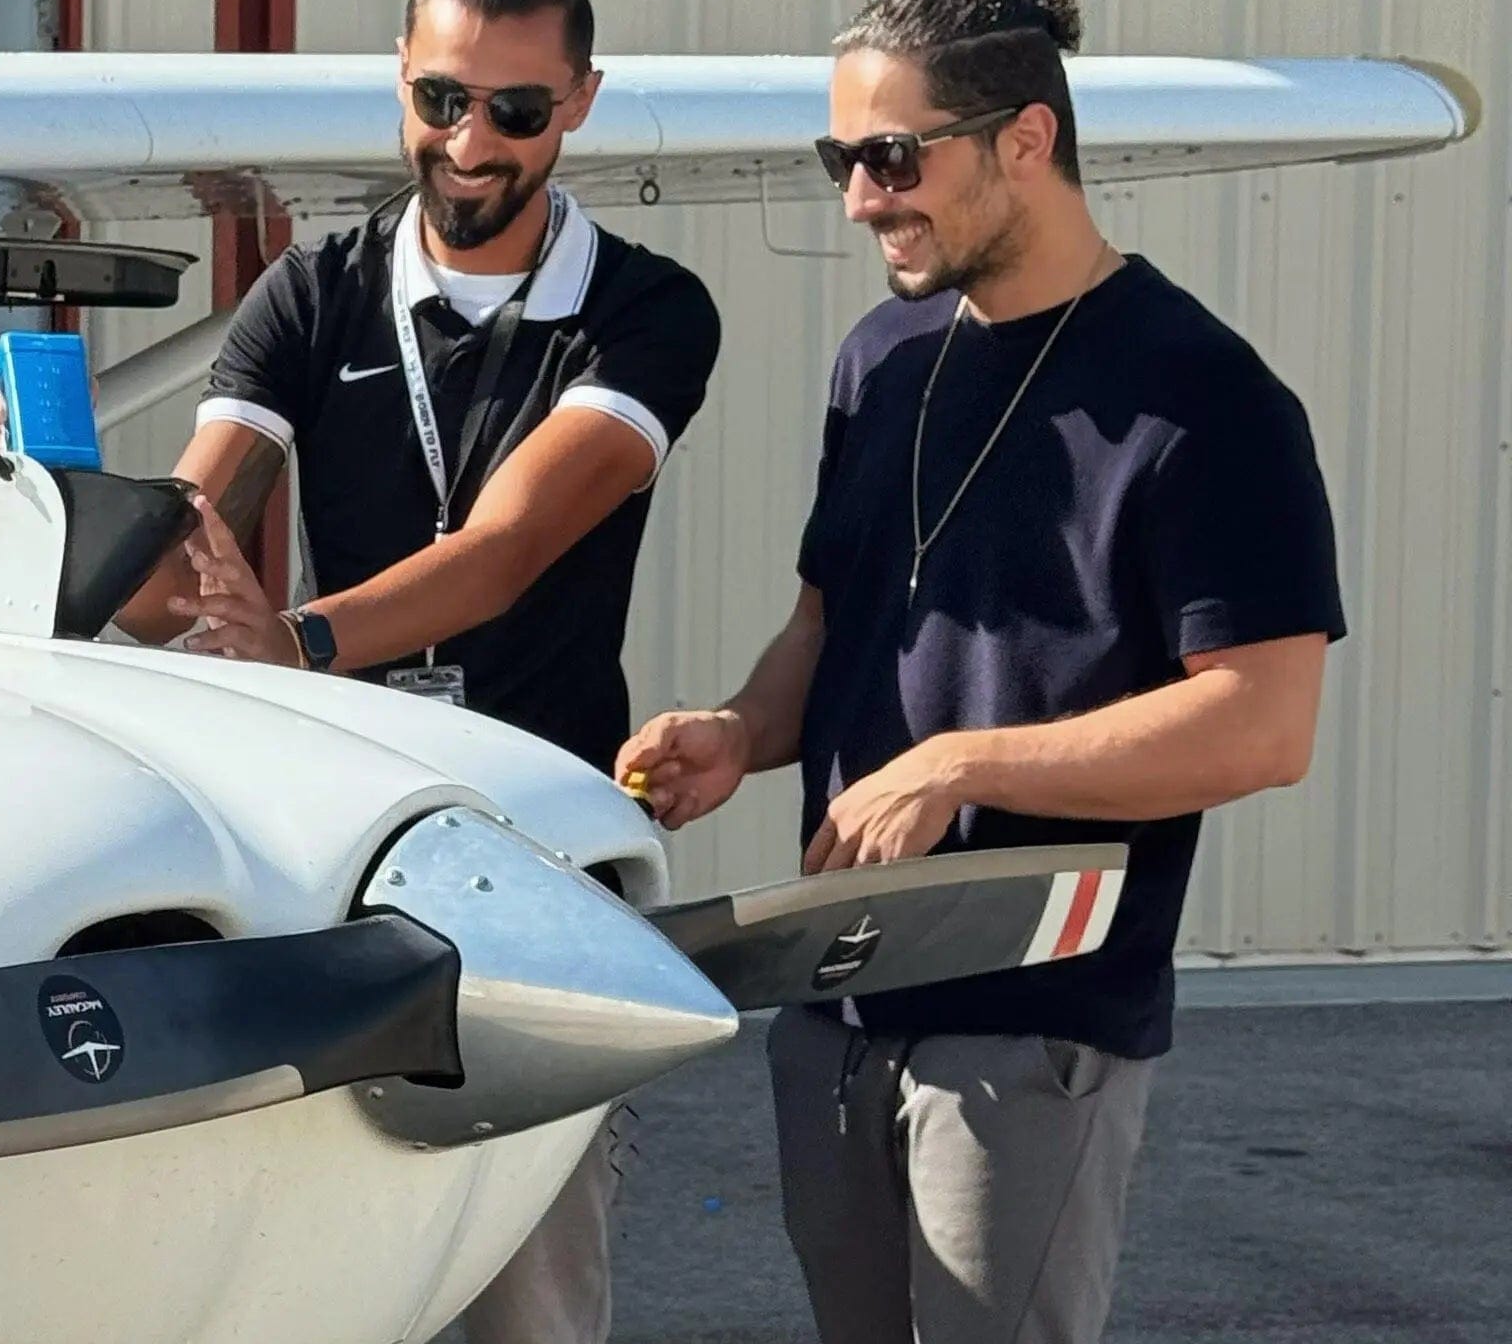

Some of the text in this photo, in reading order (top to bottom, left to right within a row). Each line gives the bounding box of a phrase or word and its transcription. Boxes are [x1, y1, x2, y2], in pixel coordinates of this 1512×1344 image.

[414, 393, 441, 468] BORN TO FLY
